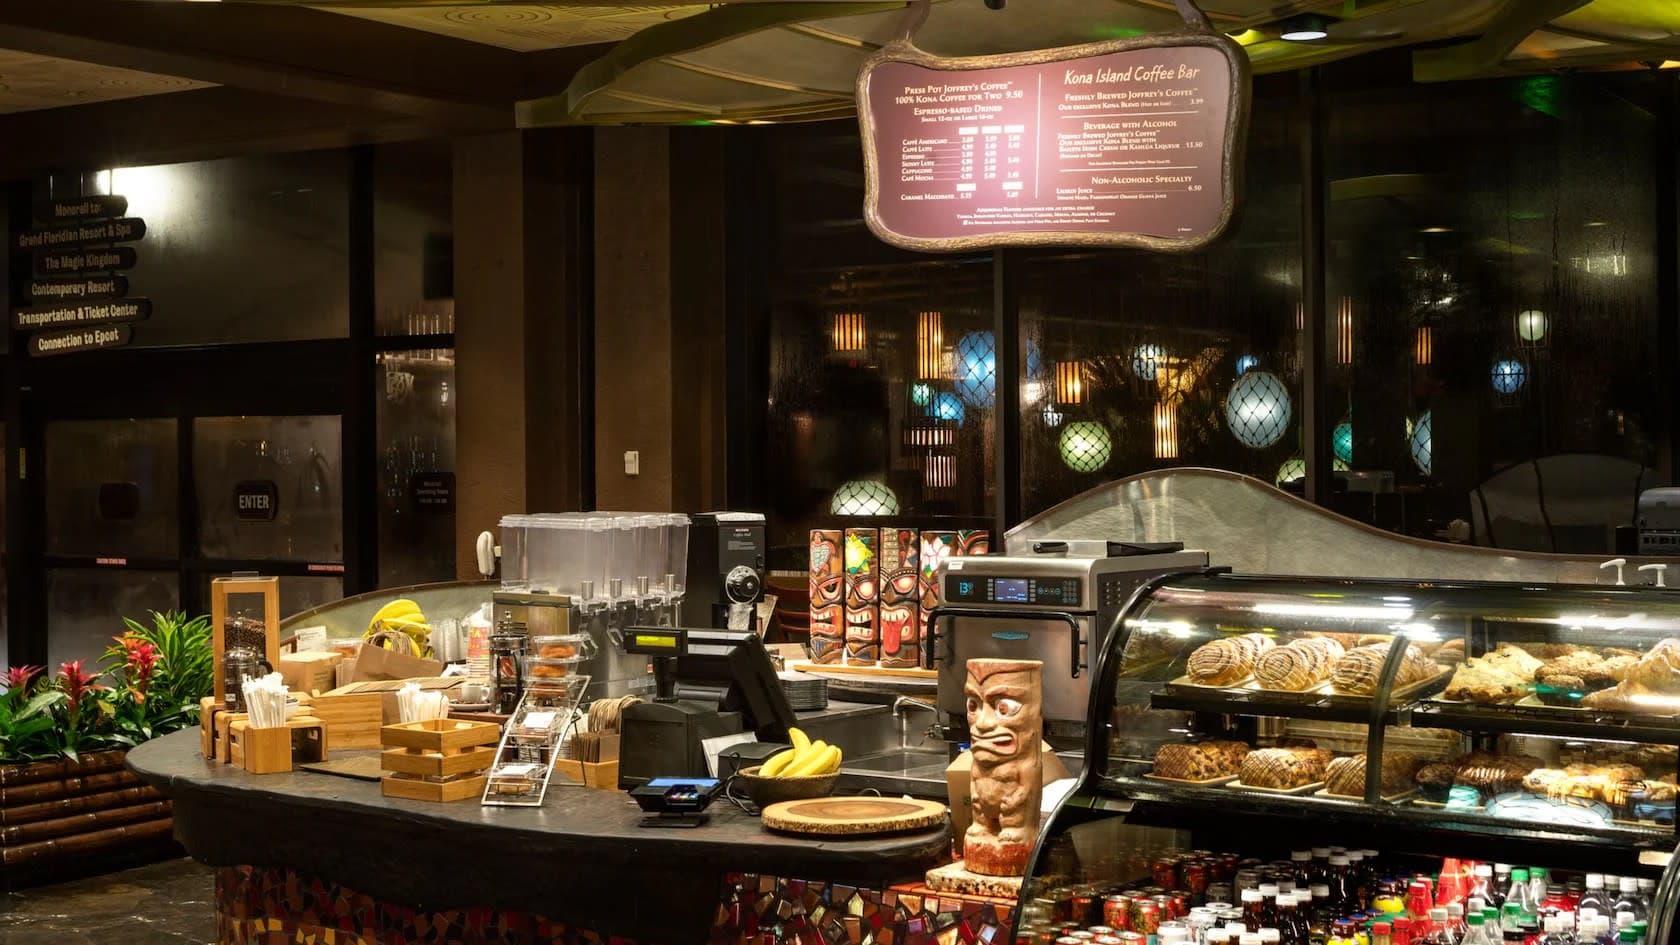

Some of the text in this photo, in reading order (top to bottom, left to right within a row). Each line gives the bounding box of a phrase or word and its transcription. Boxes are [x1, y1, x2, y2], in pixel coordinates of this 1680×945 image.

[1064, 64, 1200, 85] Kona Island Coffee Bar
[896, 96, 914, 104] 100%
[916, 95, 937, 103] KONA
[939, 94, 967, 102] COFFEE
[984, 92, 1002, 100] TWO
[1006, 90, 1023, 99] 9.50
[928, 86, 942, 94] POT
[1065, 94, 1095, 102] FRESHLY
[1128, 91, 1163, 100] JOFFREY'S
[1084, 122, 1120, 130] BEVERAGE
[1142, 120, 1176, 128] ALCOHOL
[1092, 175, 1192, 185] NON-ALCOHOLIC SPECIALTY
[55, 202, 89, 216] Monorail
[19, 224, 131, 247] Grand Floridian Resort & Spa
[45, 253, 120, 270] The Magic Kingdom
[32, 280, 114, 297] Contemporary Resort
[18, 303, 138, 325] Transportation & Ticket Center
[38, 328, 119, 350] Connection to Epcot
[239, 494, 270, 510] ENTER
